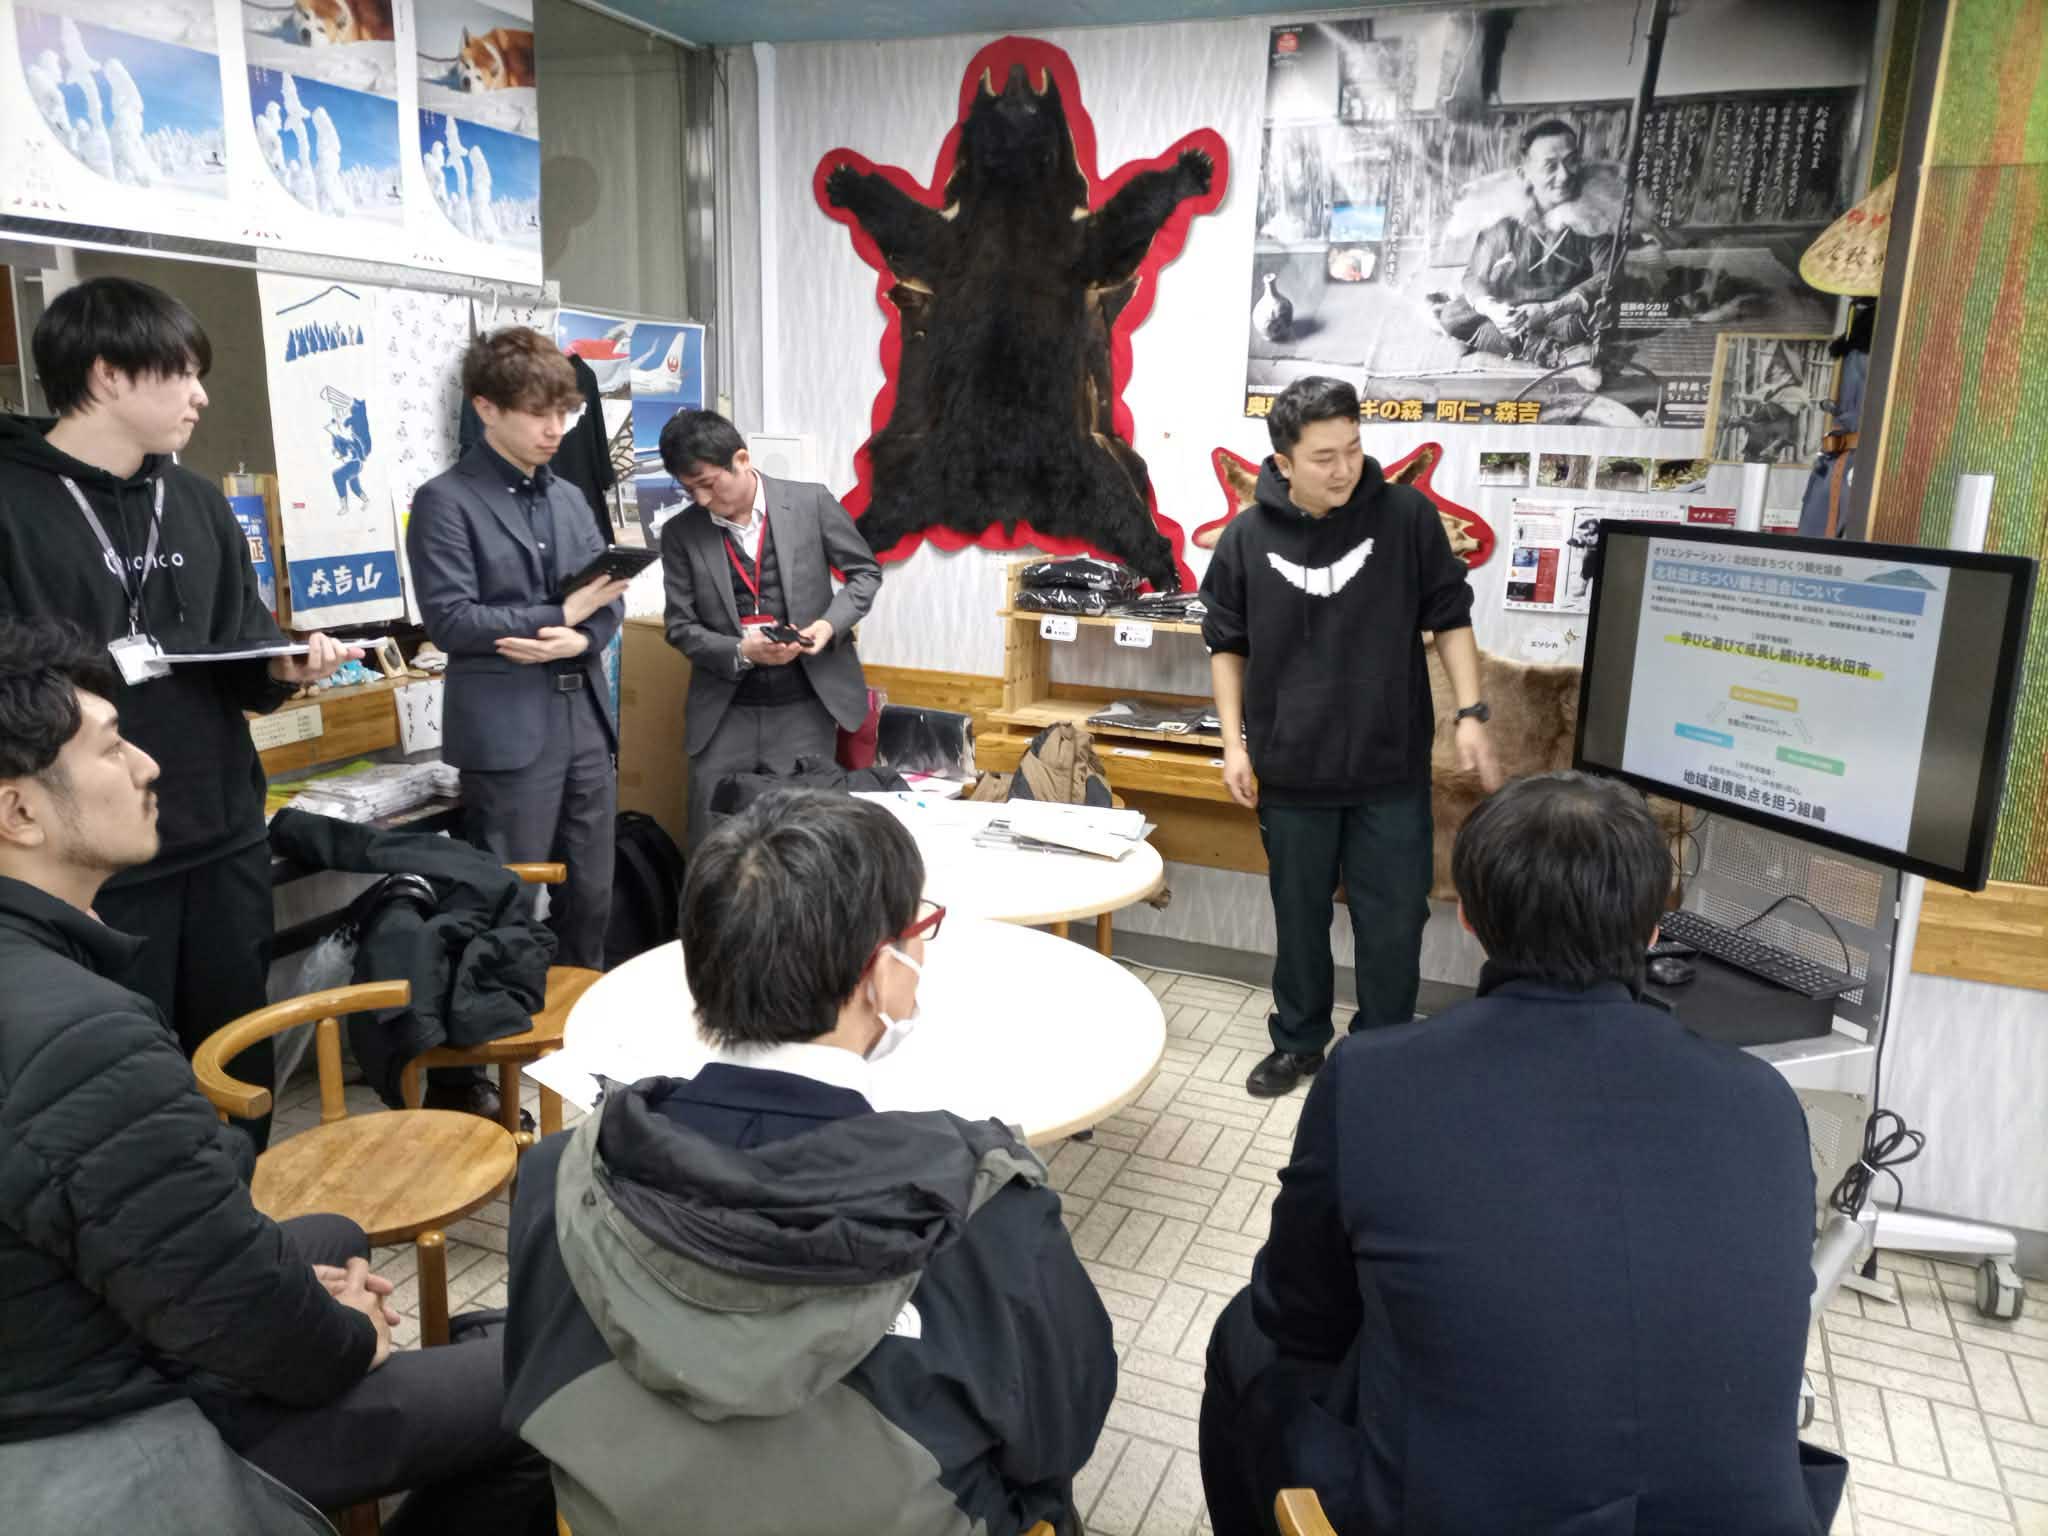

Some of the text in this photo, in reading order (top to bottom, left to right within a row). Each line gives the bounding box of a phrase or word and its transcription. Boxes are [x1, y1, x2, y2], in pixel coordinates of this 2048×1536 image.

[1436, 400, 1541, 424] 阿仁・森吉
[307, 562, 383, 598] 森吉山
[1680, 631, 1872, 677] 学びと遊びで成長し続ける北秋田市
